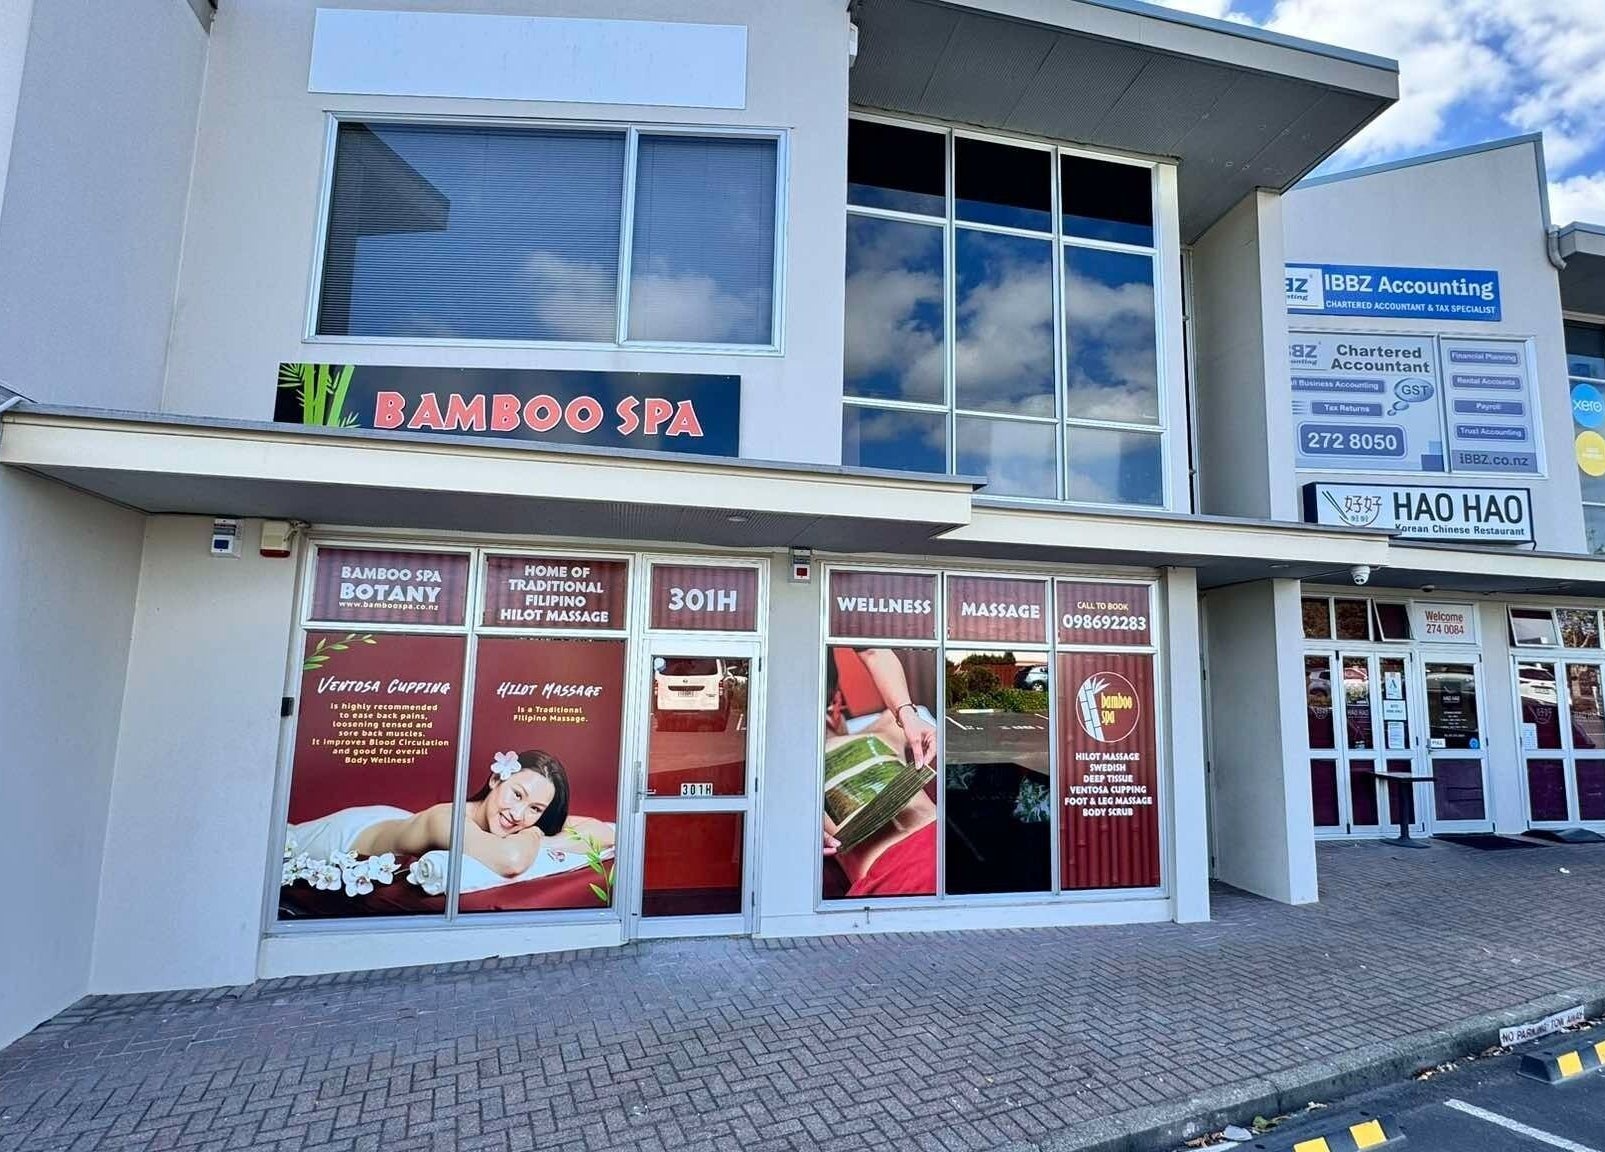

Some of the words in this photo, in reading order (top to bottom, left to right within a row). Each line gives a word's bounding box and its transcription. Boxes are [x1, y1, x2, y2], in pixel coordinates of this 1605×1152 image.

[1324, 274, 1373, 292] IBBZ
[1377, 277, 1495, 301] Accounting
[1325, 300, 1372, 310] CHARTERED
[1374, 303, 1425, 312] ACCOUNTANT
[1427, 304, 1433, 312] &
[1435, 304, 1450, 313] TAX
[1450, 305, 1496, 314] SPECIALIST
[1336, 344, 1422, 359] Chartered
[1331, 358, 1431, 373] Accountant
[1298, 379, 1334, 388] Business
[1334, 382, 1379, 390] Accounting
[1401, 384, 1430, 396] GST
[1340, 404, 1370, 412] Returns
[1573, 400, 1602, 412] xero
[373, 391, 604, 434] BAMBOO
[616, 396, 705, 437] SPA
[1460, 426, 1480, 434] Trust
[1481, 428, 1522, 437] Accounting
[1307, 431, 1345, 449] 272
[1349, 433, 1398, 450] 8050
[1344, 495, 1383, 514] 好好
[1393, 492, 1454, 522] HAO
[1463, 494, 1523, 524] HAO
[1432, 525, 1470, 535] Chinese
[1474, 526, 1524, 536] Restaurant
[341, 566, 412, 581] BAMBOO
[415, 569, 442, 582] SPA
[524, 565, 568, 577] HOME
[571, 566, 591, 578] OF
[340, 582, 441, 603] BOTANY
[508, 579, 604, 594] TRADITIONAL
[339, 601, 439, 611] www.bamboospa.co.nz
[525, 594, 587, 607] FILIPINO
[668, 587, 738, 613] 301H
[836, 595, 932, 615] WELLNESS
[1077, 601, 1095, 609] CALL
[1095, 602, 1106, 610] TO
[1107, 602, 1129, 611] BOOK
[500, 608, 543, 621] HILOT
[545, 609, 609, 623] MASSAGE
[960, 601, 1041, 619] MASSAGE
[1424, 610, 1464, 622] Welcome
[1062, 613, 1147, 631] 098692283
[1426, 623, 1442, 634] 274
[1443, 624, 1464, 635] 0084
[341, 702, 371, 711] highly
[373, 703, 439, 711] recommended
[1100, 691, 1133, 710] bamboo
[535, 705, 582, 714] Traditional
[339, 711, 350, 719] to
[400, 713, 429, 721] pains,
[513, 714, 548, 723] Filipino
[549, 715, 589, 723] Massage.
[1101, 710, 1116, 726] spa
[332, 720, 379, 729] loosening
[381, 721, 413, 729] tensed
[415, 721, 433, 729] and
[361, 729, 383, 737] back
[312, 738, 320, 746] It
[398, 739, 450, 747] Circulation
[379, 748, 393, 756] for
[395, 748, 429, 756] overall
[1075, 752, 1101, 761] HILOT
[1102, 752, 1141, 761] MASSAGE
[344, 757, 368, 765] Body
[370, 757, 415, 765] Wellness!
[1089, 763, 1126, 772] SWEDISH
[1083, 774, 1105, 783] DEEP
[1106, 774, 1134, 783] TISSUE
[681, 783, 713, 795] 301H
[1069, 785, 1109, 794] VENTOSA
[1110, 785, 1147, 794] CUPPING
[1064, 797, 1088, 806] FOOT
[1089, 797, 1097, 805] &
[1098, 797, 1114, 805] LEG
[1114, 796, 1153, 805] MASSAGE
[1082, 807, 1106, 816] BODY
[1107, 807, 1134, 816] SCRUB
[1502, 1031, 1514, 1042] NO
